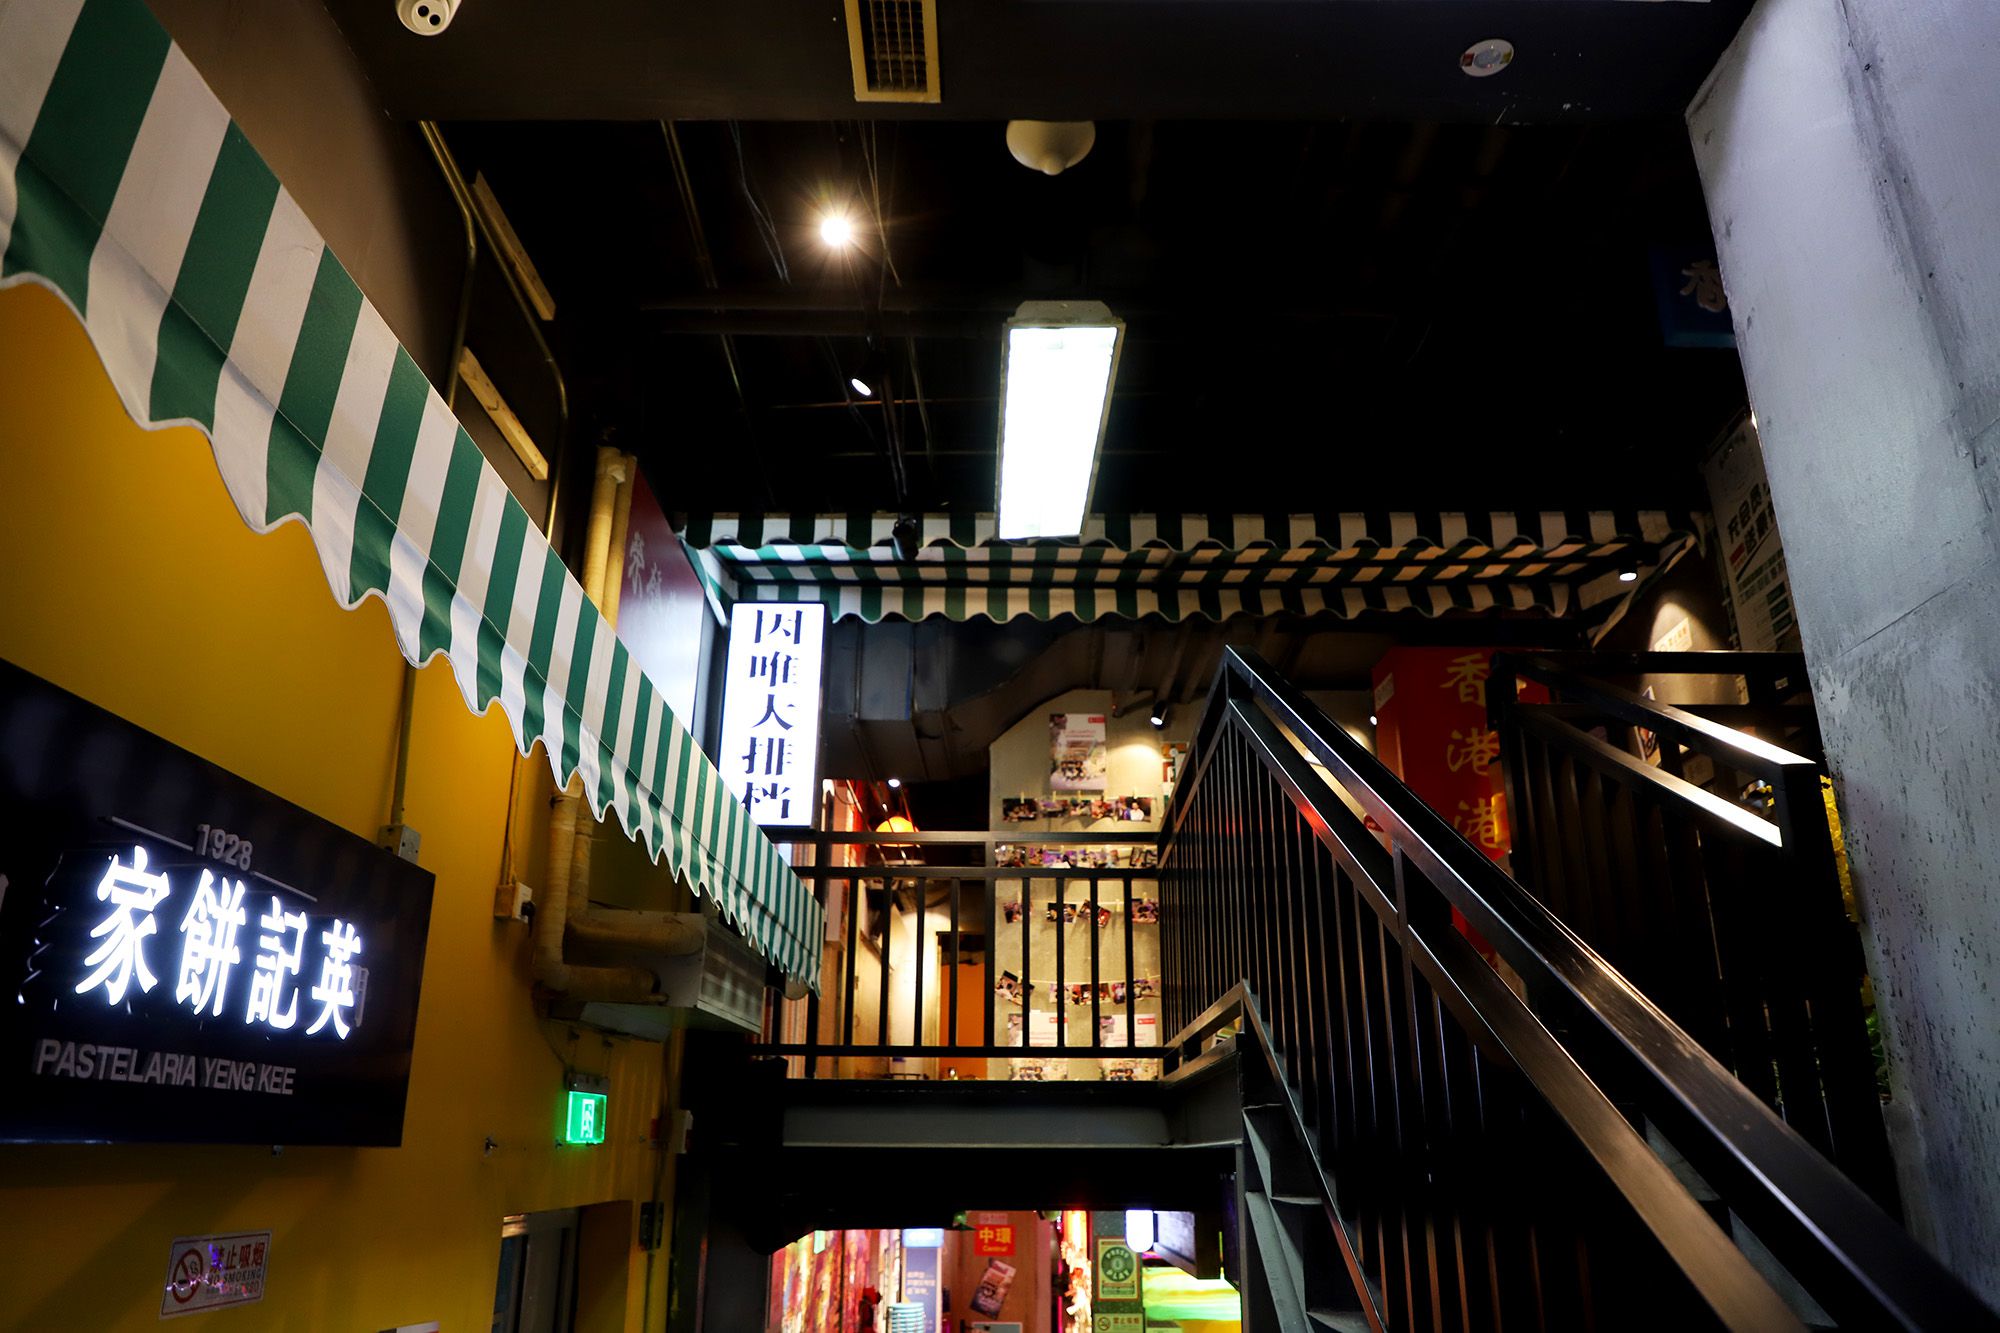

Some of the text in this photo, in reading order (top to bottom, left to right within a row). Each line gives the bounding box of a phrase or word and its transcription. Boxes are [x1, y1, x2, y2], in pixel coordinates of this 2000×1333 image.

[196, 824, 253, 871] 1928
[35, 1039, 297, 1096] PASTELARIA YENG KEE
[223, 1269, 262, 1283] SMOKING
